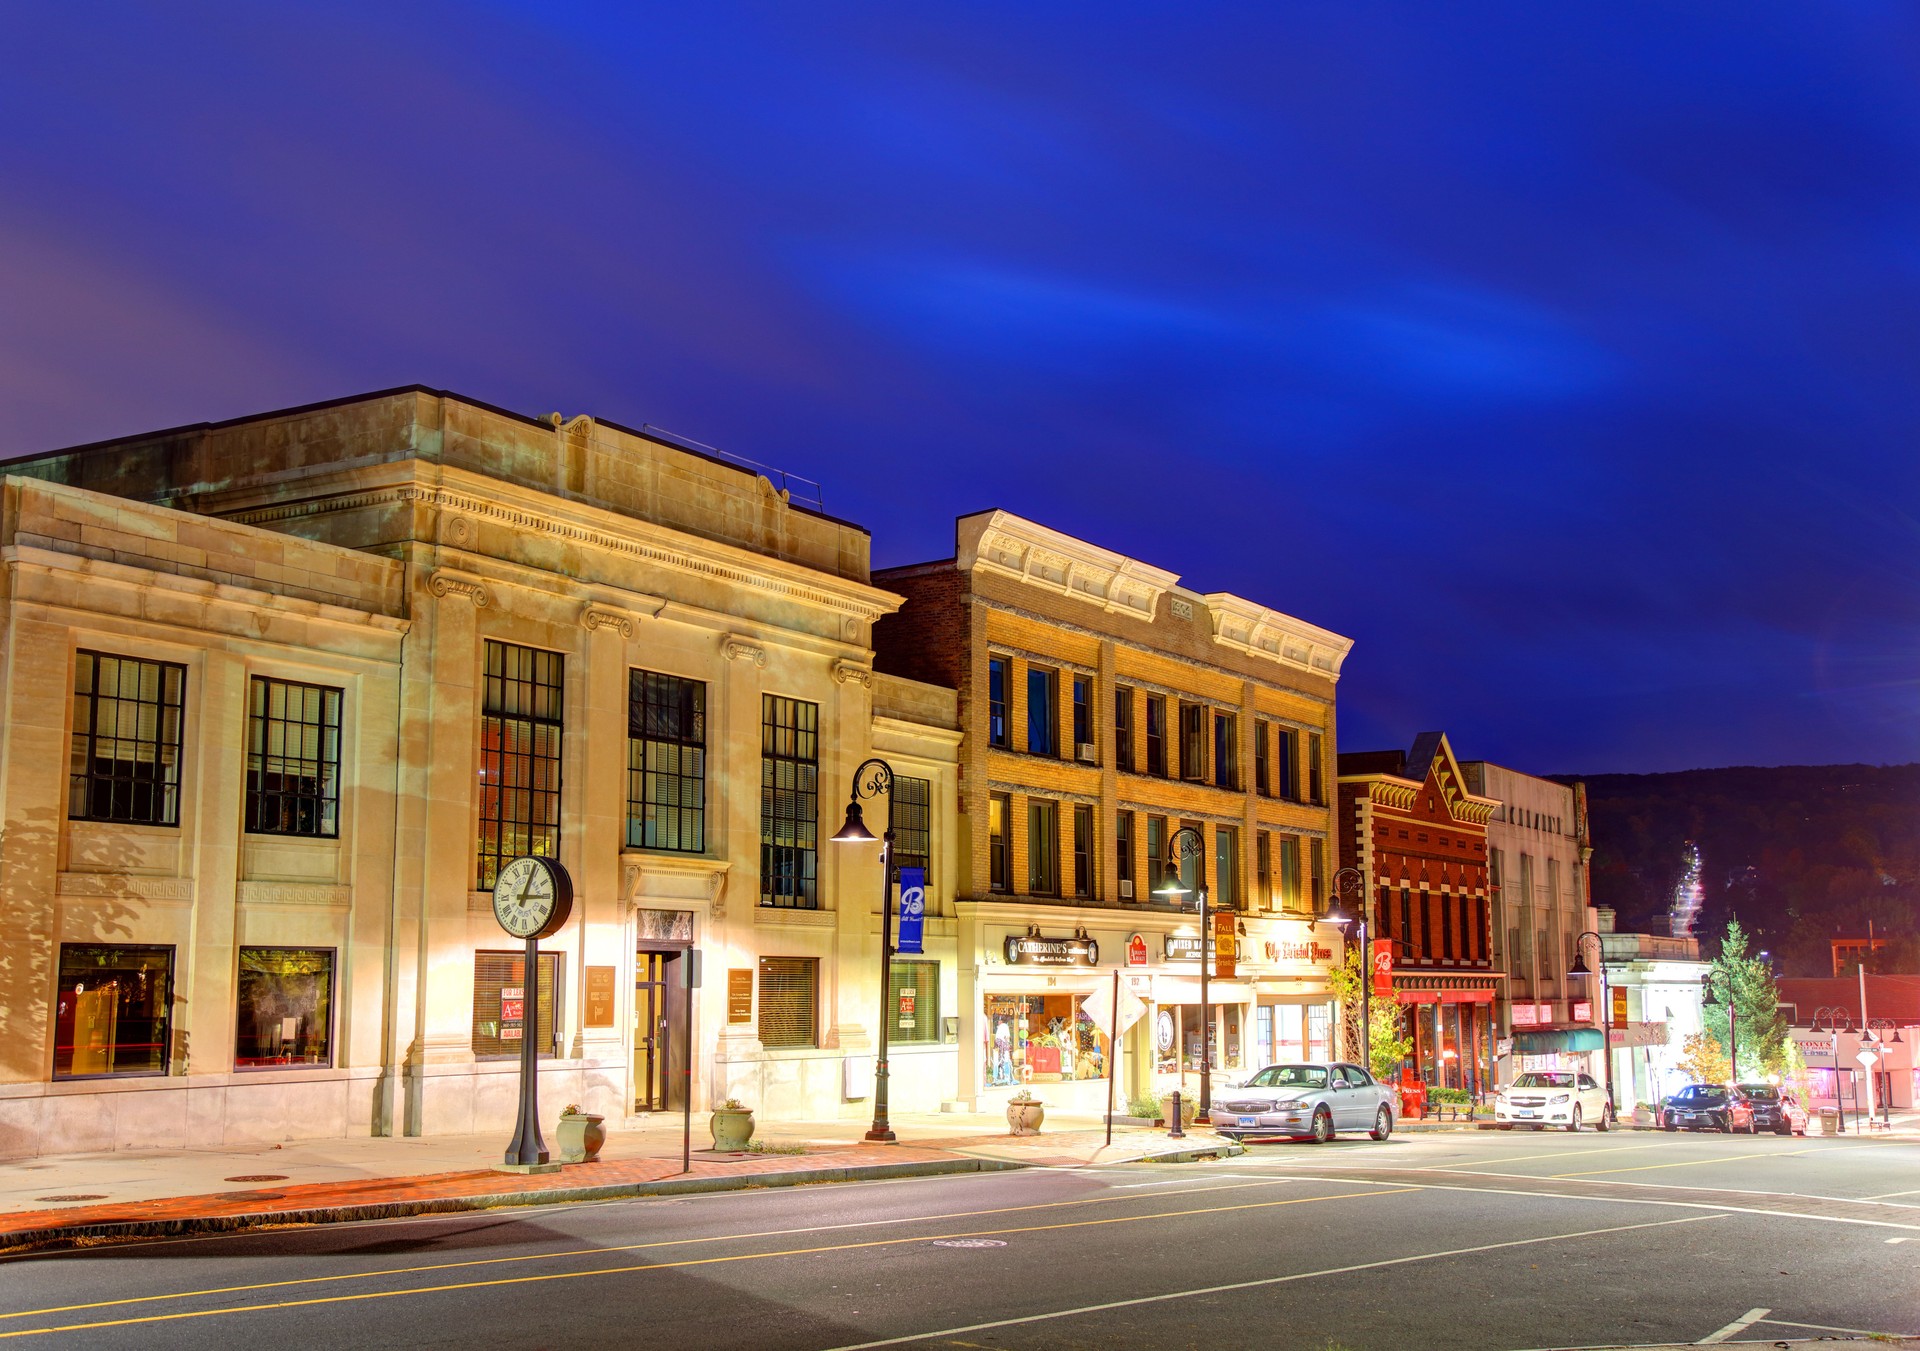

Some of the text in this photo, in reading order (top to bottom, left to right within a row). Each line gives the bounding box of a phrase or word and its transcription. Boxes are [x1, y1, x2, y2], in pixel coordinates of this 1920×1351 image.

[511, 877, 526, 896] UNITED
[515, 907, 532, 917] TRUST
[1217, 924, 1232, 932] FALL
[1017, 941, 1067, 954] CATHERINE'S
[1173, 940, 1192, 950] MIXED
[1310, 941, 1333, 964] Press
